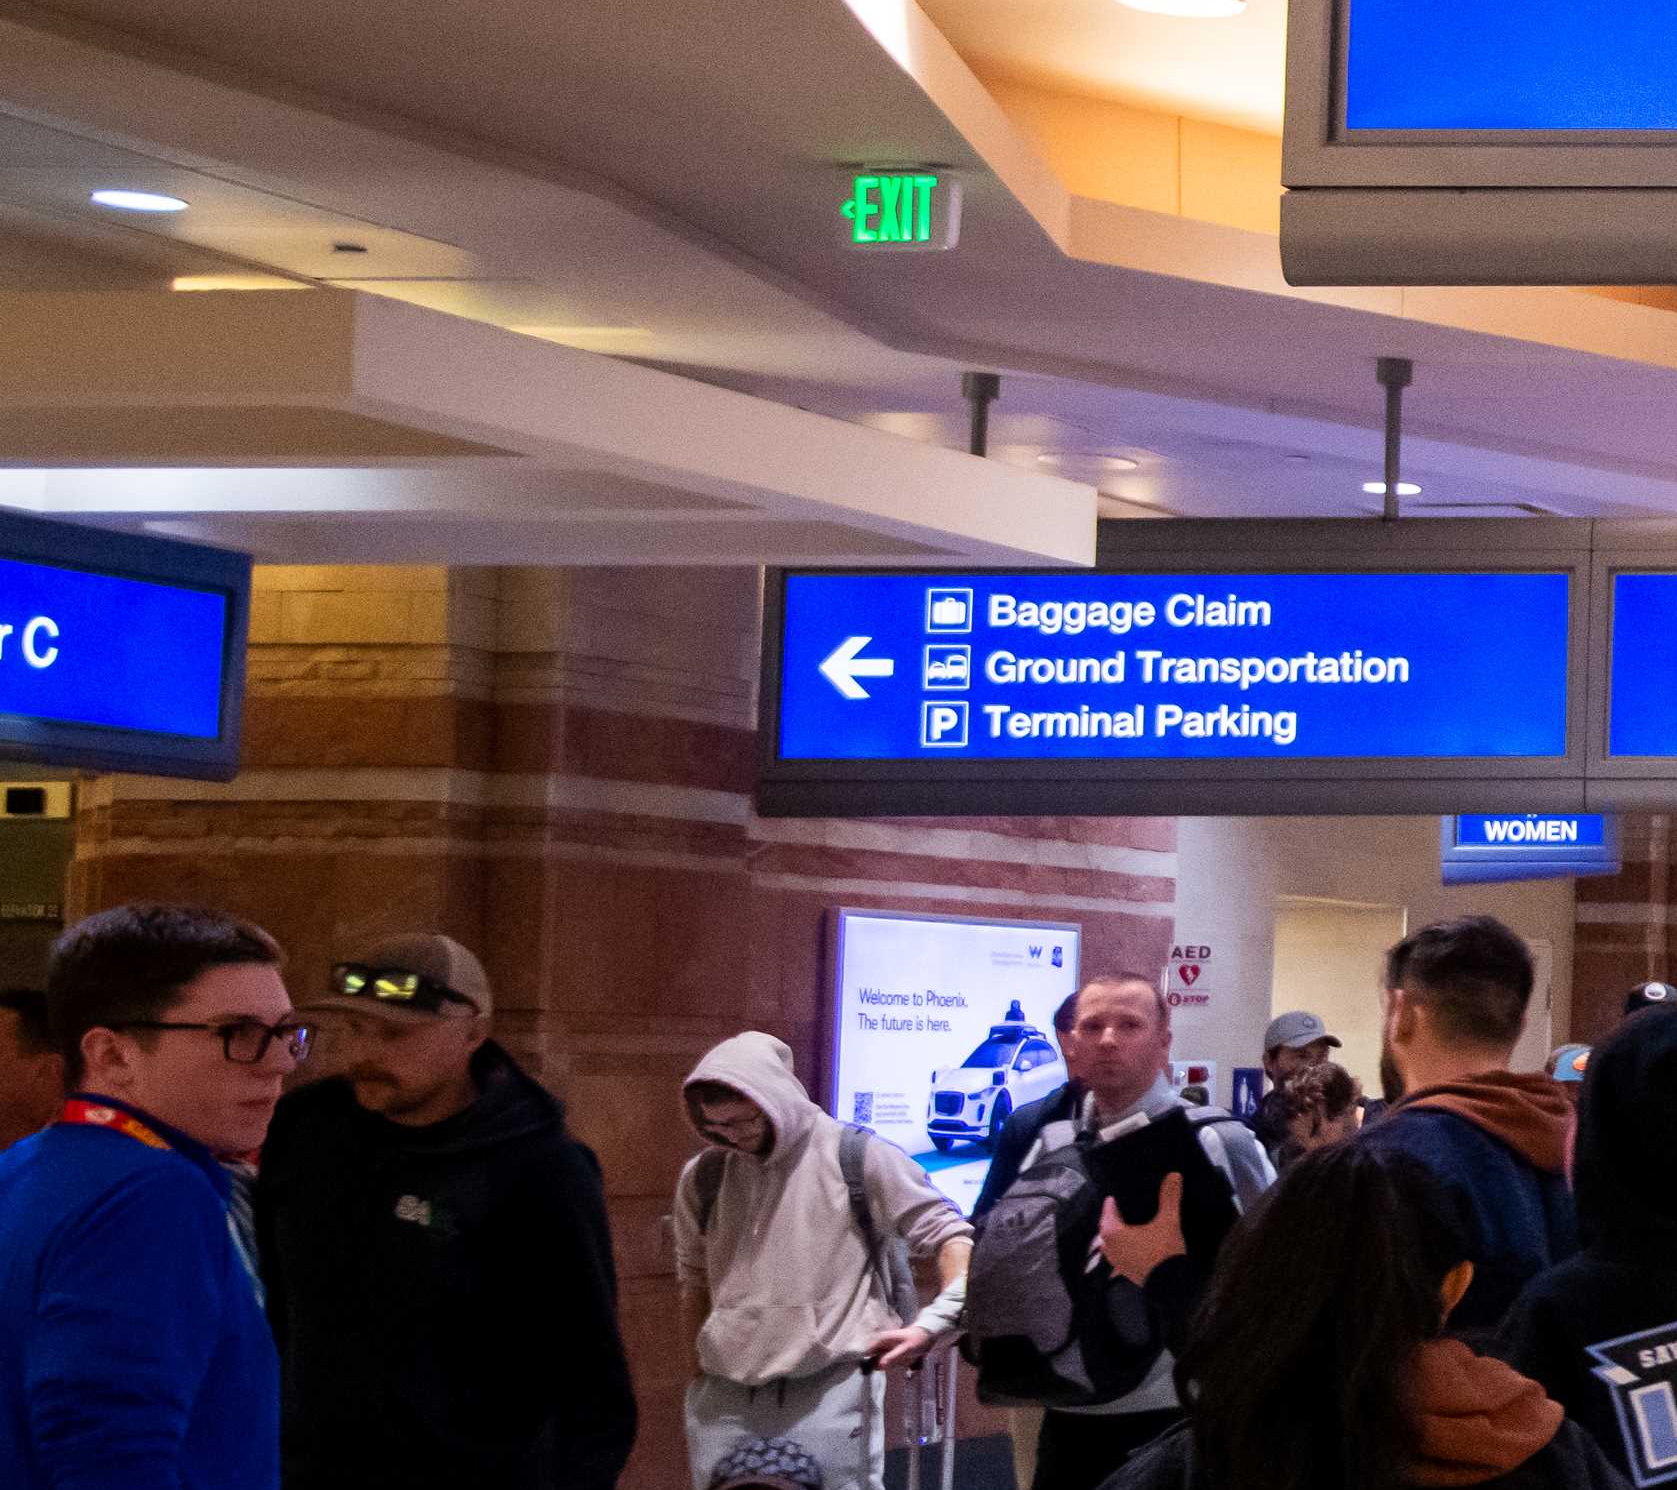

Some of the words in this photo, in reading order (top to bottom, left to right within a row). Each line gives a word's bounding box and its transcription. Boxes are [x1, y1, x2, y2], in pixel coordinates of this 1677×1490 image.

[853, 175, 937, 243] EXIT
[989, 594, 1156, 634] Baggage
[1166, 593, 1271, 626] Claim
[985, 650, 1125, 683] Ground
[1135, 650, 1410, 690] Transportation
[984, 704, 1145, 738] Terminal
[1156, 704, 1298, 745] Parking
[1484, 820, 1578, 842] WOMEN
[1171, 946, 1212, 959] AED
[858, 988, 910, 1007] Welcome
[913, 990, 924, 1007] to
[926, 990, 969, 1008] Phoenix.
[858, 1012, 878, 1031] The
[880, 1013, 914, 1032] future
[916, 1015, 924, 1031] is
[926, 1015, 952, 1032] here.
